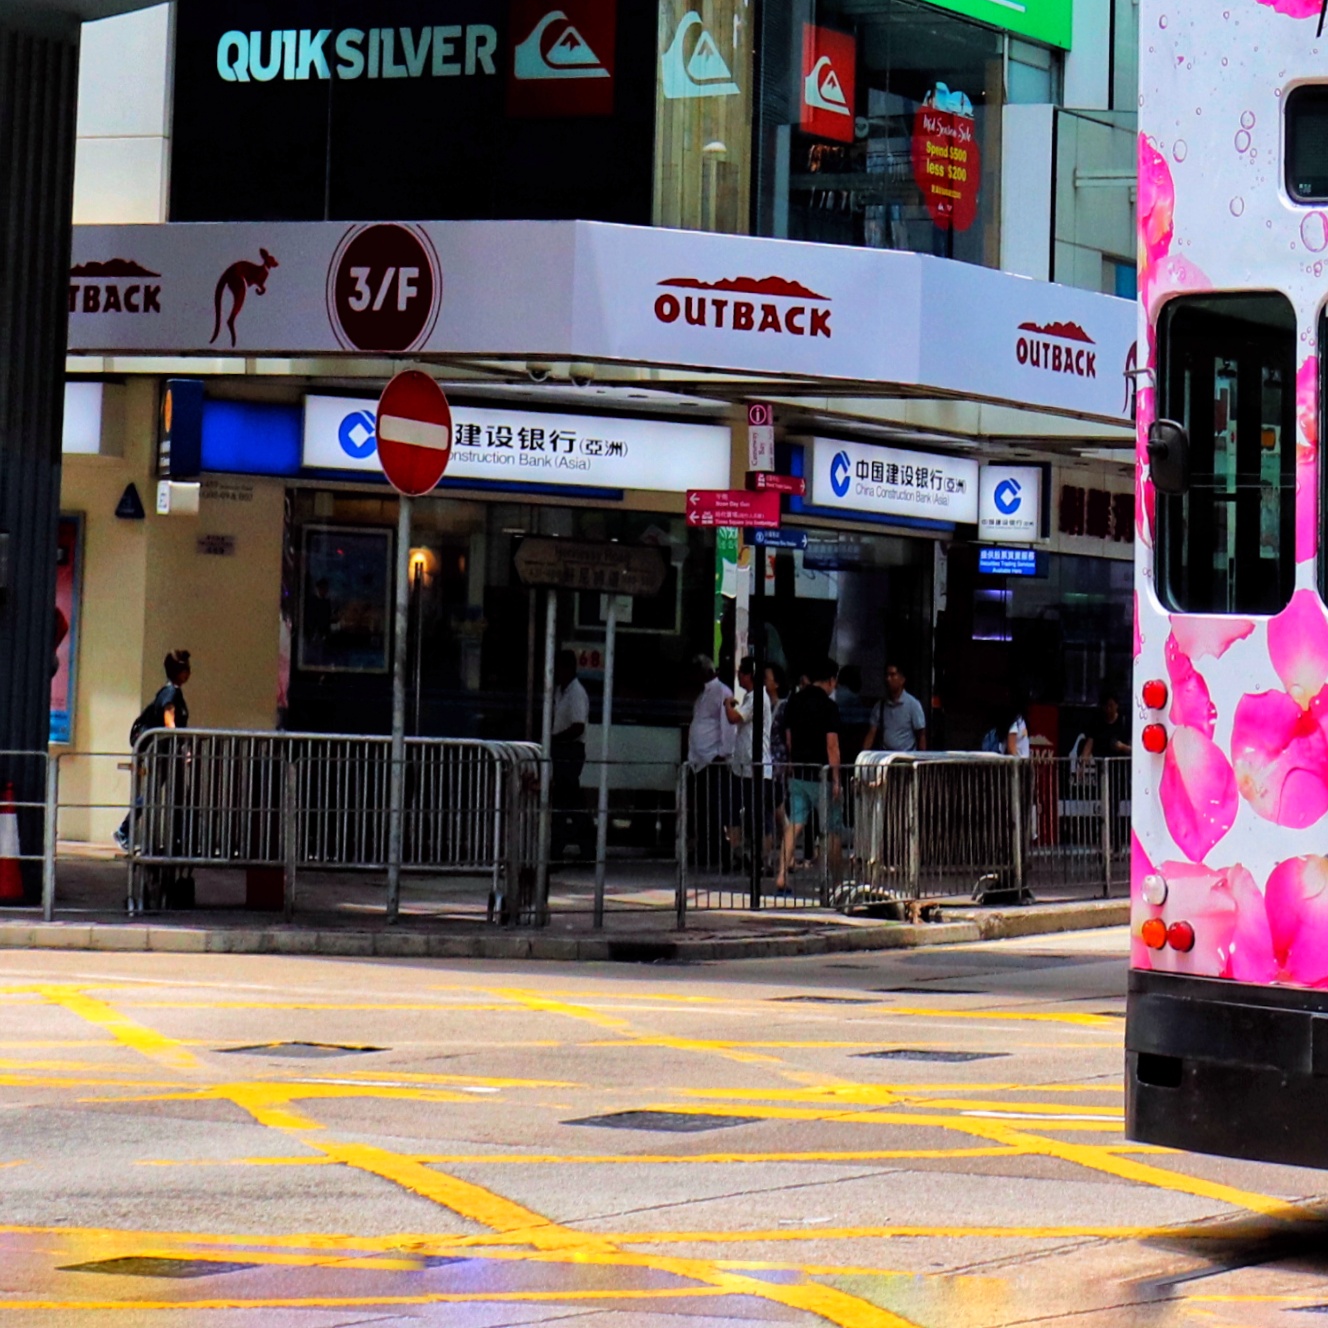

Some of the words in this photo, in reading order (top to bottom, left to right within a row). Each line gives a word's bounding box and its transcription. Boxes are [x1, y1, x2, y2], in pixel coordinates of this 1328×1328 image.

[217, 25, 497, 83] QUIKSILVER
[926, 158, 945, 177] less
[68, 284, 161, 314] TBACK
[348, 266, 420, 312] 3/F
[654, 294, 832, 339] OUTBACK
[1016, 336, 1096, 378] OUTBACK
[455, 423, 629, 458] 建设银行(亞洲)
[449, 451, 516, 465] onstruction
[519, 453, 552, 469] Bank
[555, 456, 591, 471] (Asia)
[855, 459, 967, 494] 中国建设银行(亞洲)
[855, 482, 875, 498] China
[876, 486, 914, 503] Construction
[915, 491, 932, 504] Bank
[932, 492, 950, 508] (Asia)
